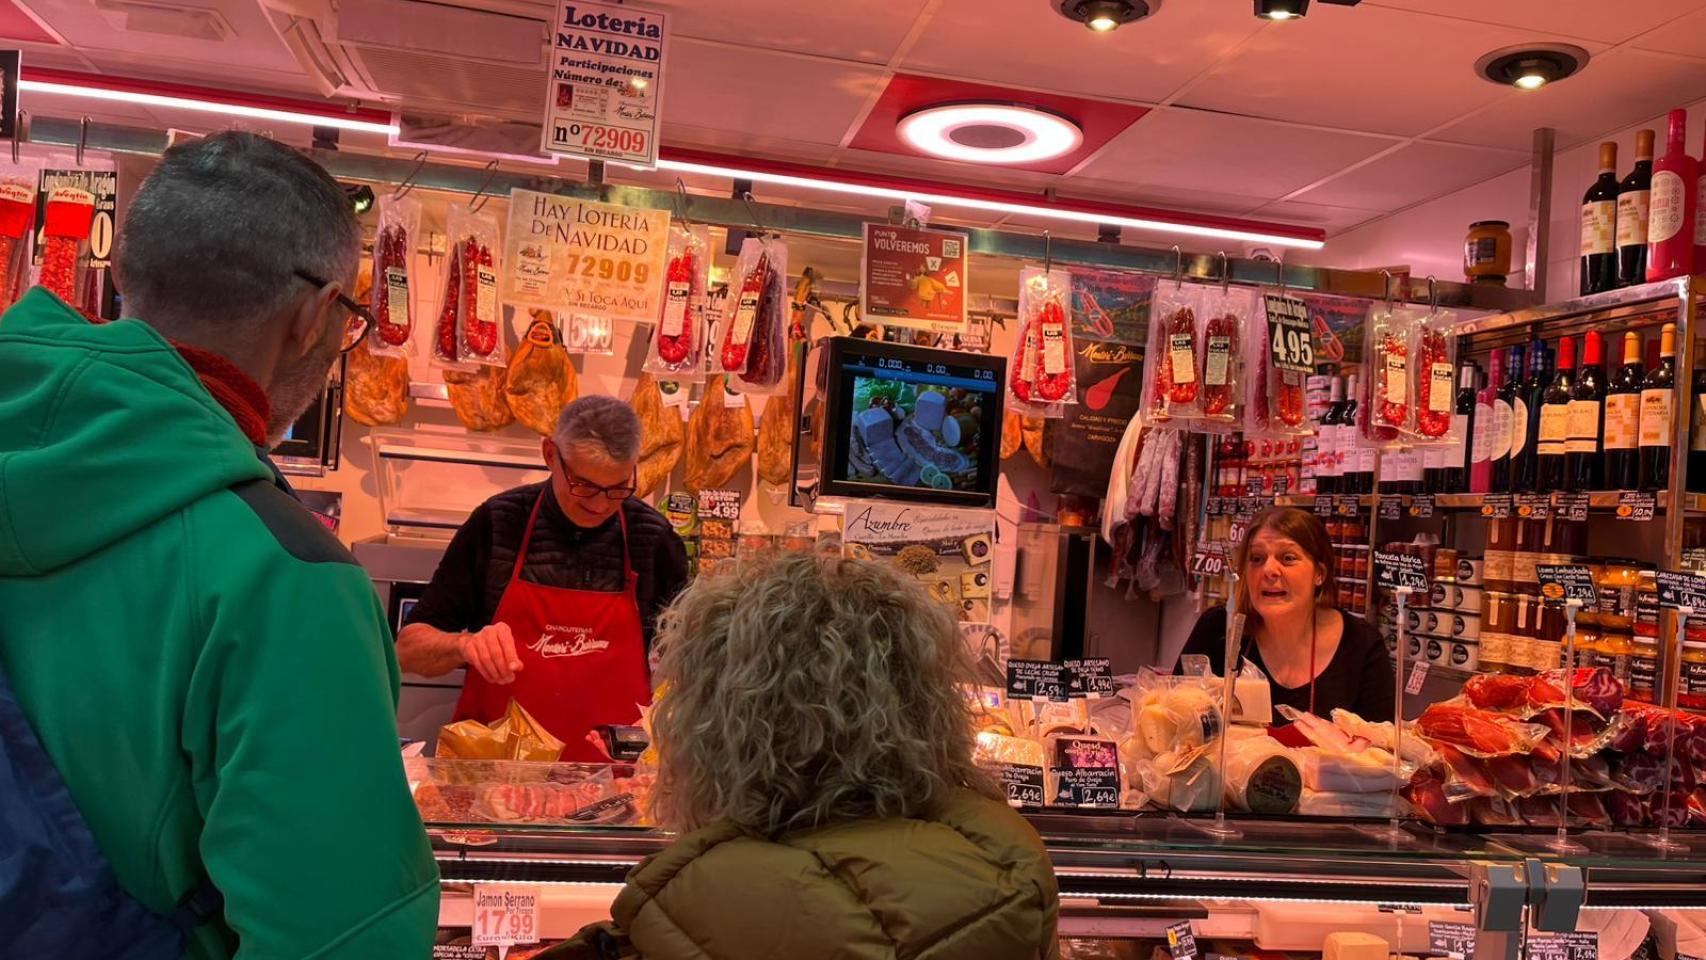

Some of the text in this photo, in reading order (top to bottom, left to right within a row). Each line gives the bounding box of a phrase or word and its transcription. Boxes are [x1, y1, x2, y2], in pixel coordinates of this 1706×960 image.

[564, 6, 660, 38] Lotería
[556, 33, 660, 61] NAVIDAD
[553, 69, 623, 88] Número de:
[560, 56, 653, 79] Participaciones
[581, 125, 645, 154] 72909
[533, 196, 649, 232] HAY LOTERÍA
[531, 220, 648, 255] DE NAVIDAD
[874, 238, 930, 255] VOLVEREMOS
[567, 254, 649, 284] 72909
[589, 291, 618, 306] TOCA
[712, 506, 739, 518] 4,99
[848, 505, 911, 533] Azumbre
[504, 891, 535, 907] Serrano
